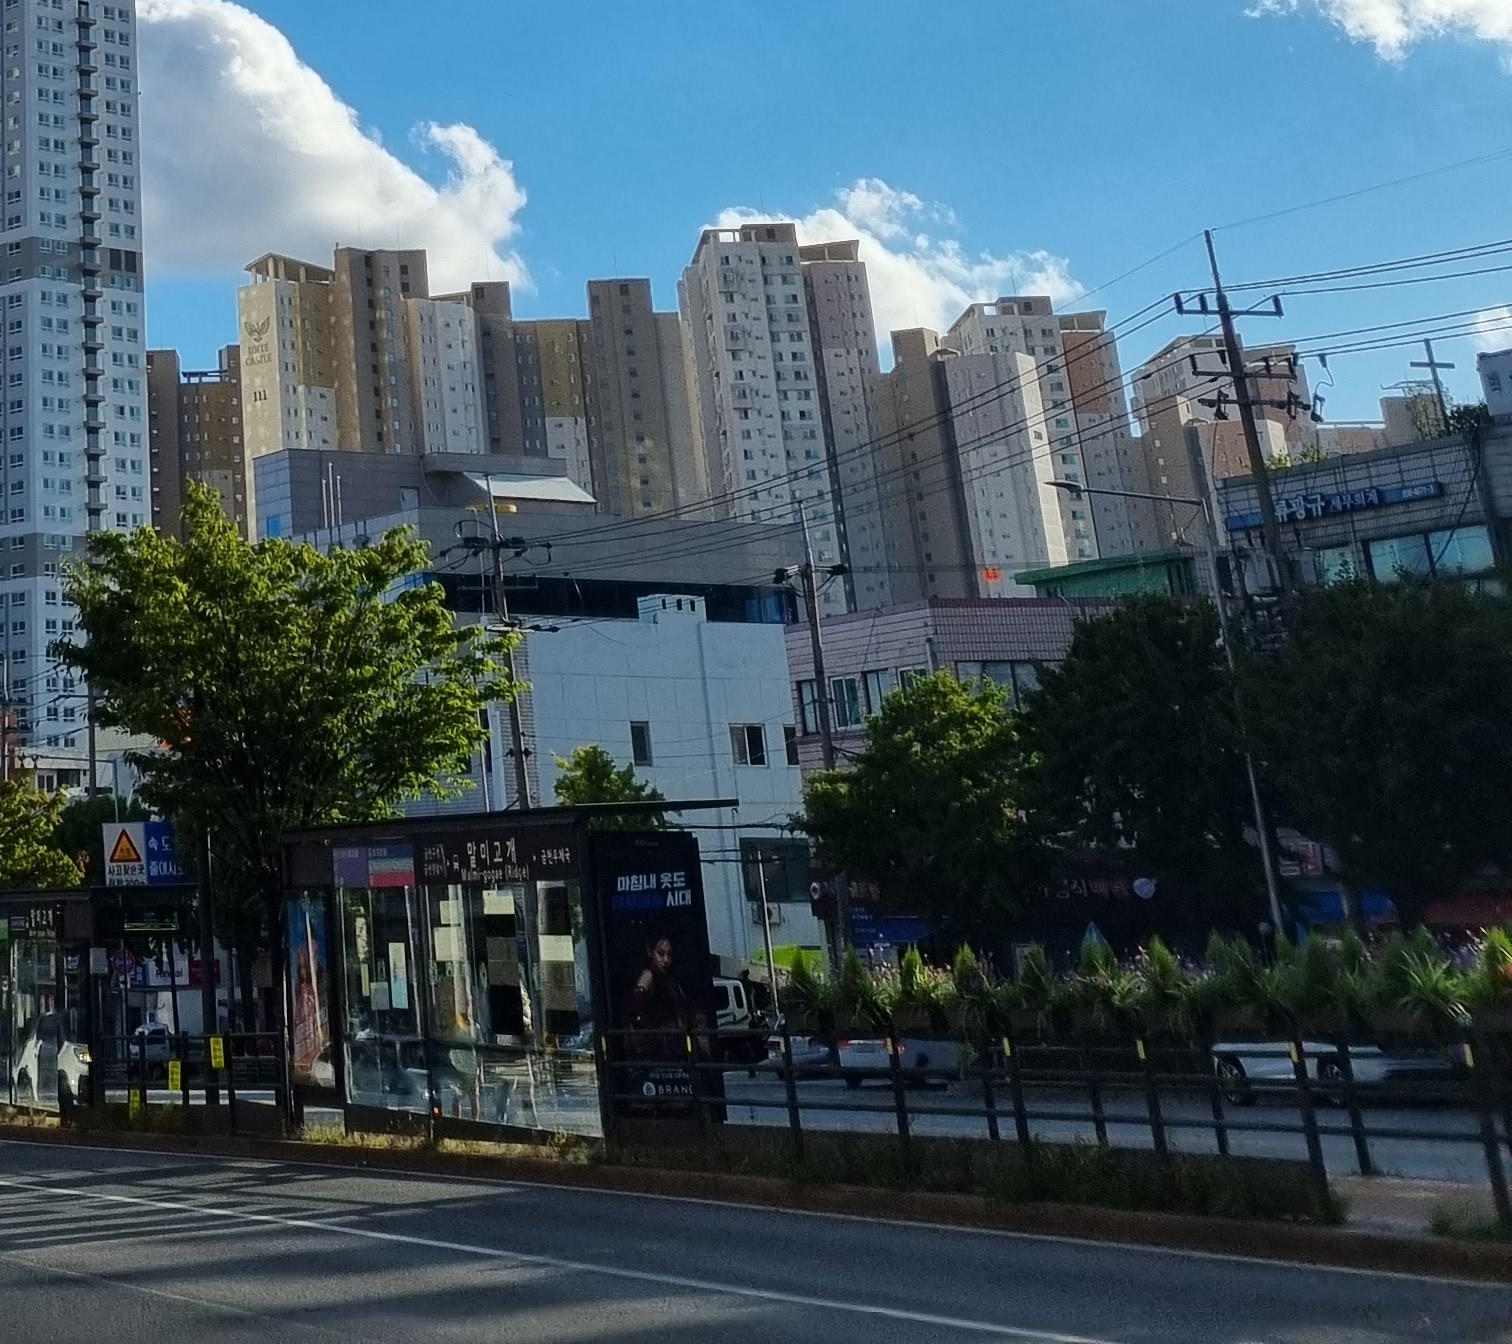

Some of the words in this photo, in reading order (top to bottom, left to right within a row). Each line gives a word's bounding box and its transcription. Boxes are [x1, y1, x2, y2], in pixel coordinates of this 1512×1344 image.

[466, 837, 518, 868] 말미고개
[616, 873, 657, 892] 마침내
[659, 871, 686, 889] 옷도
[666, 889, 692, 907] 시대
